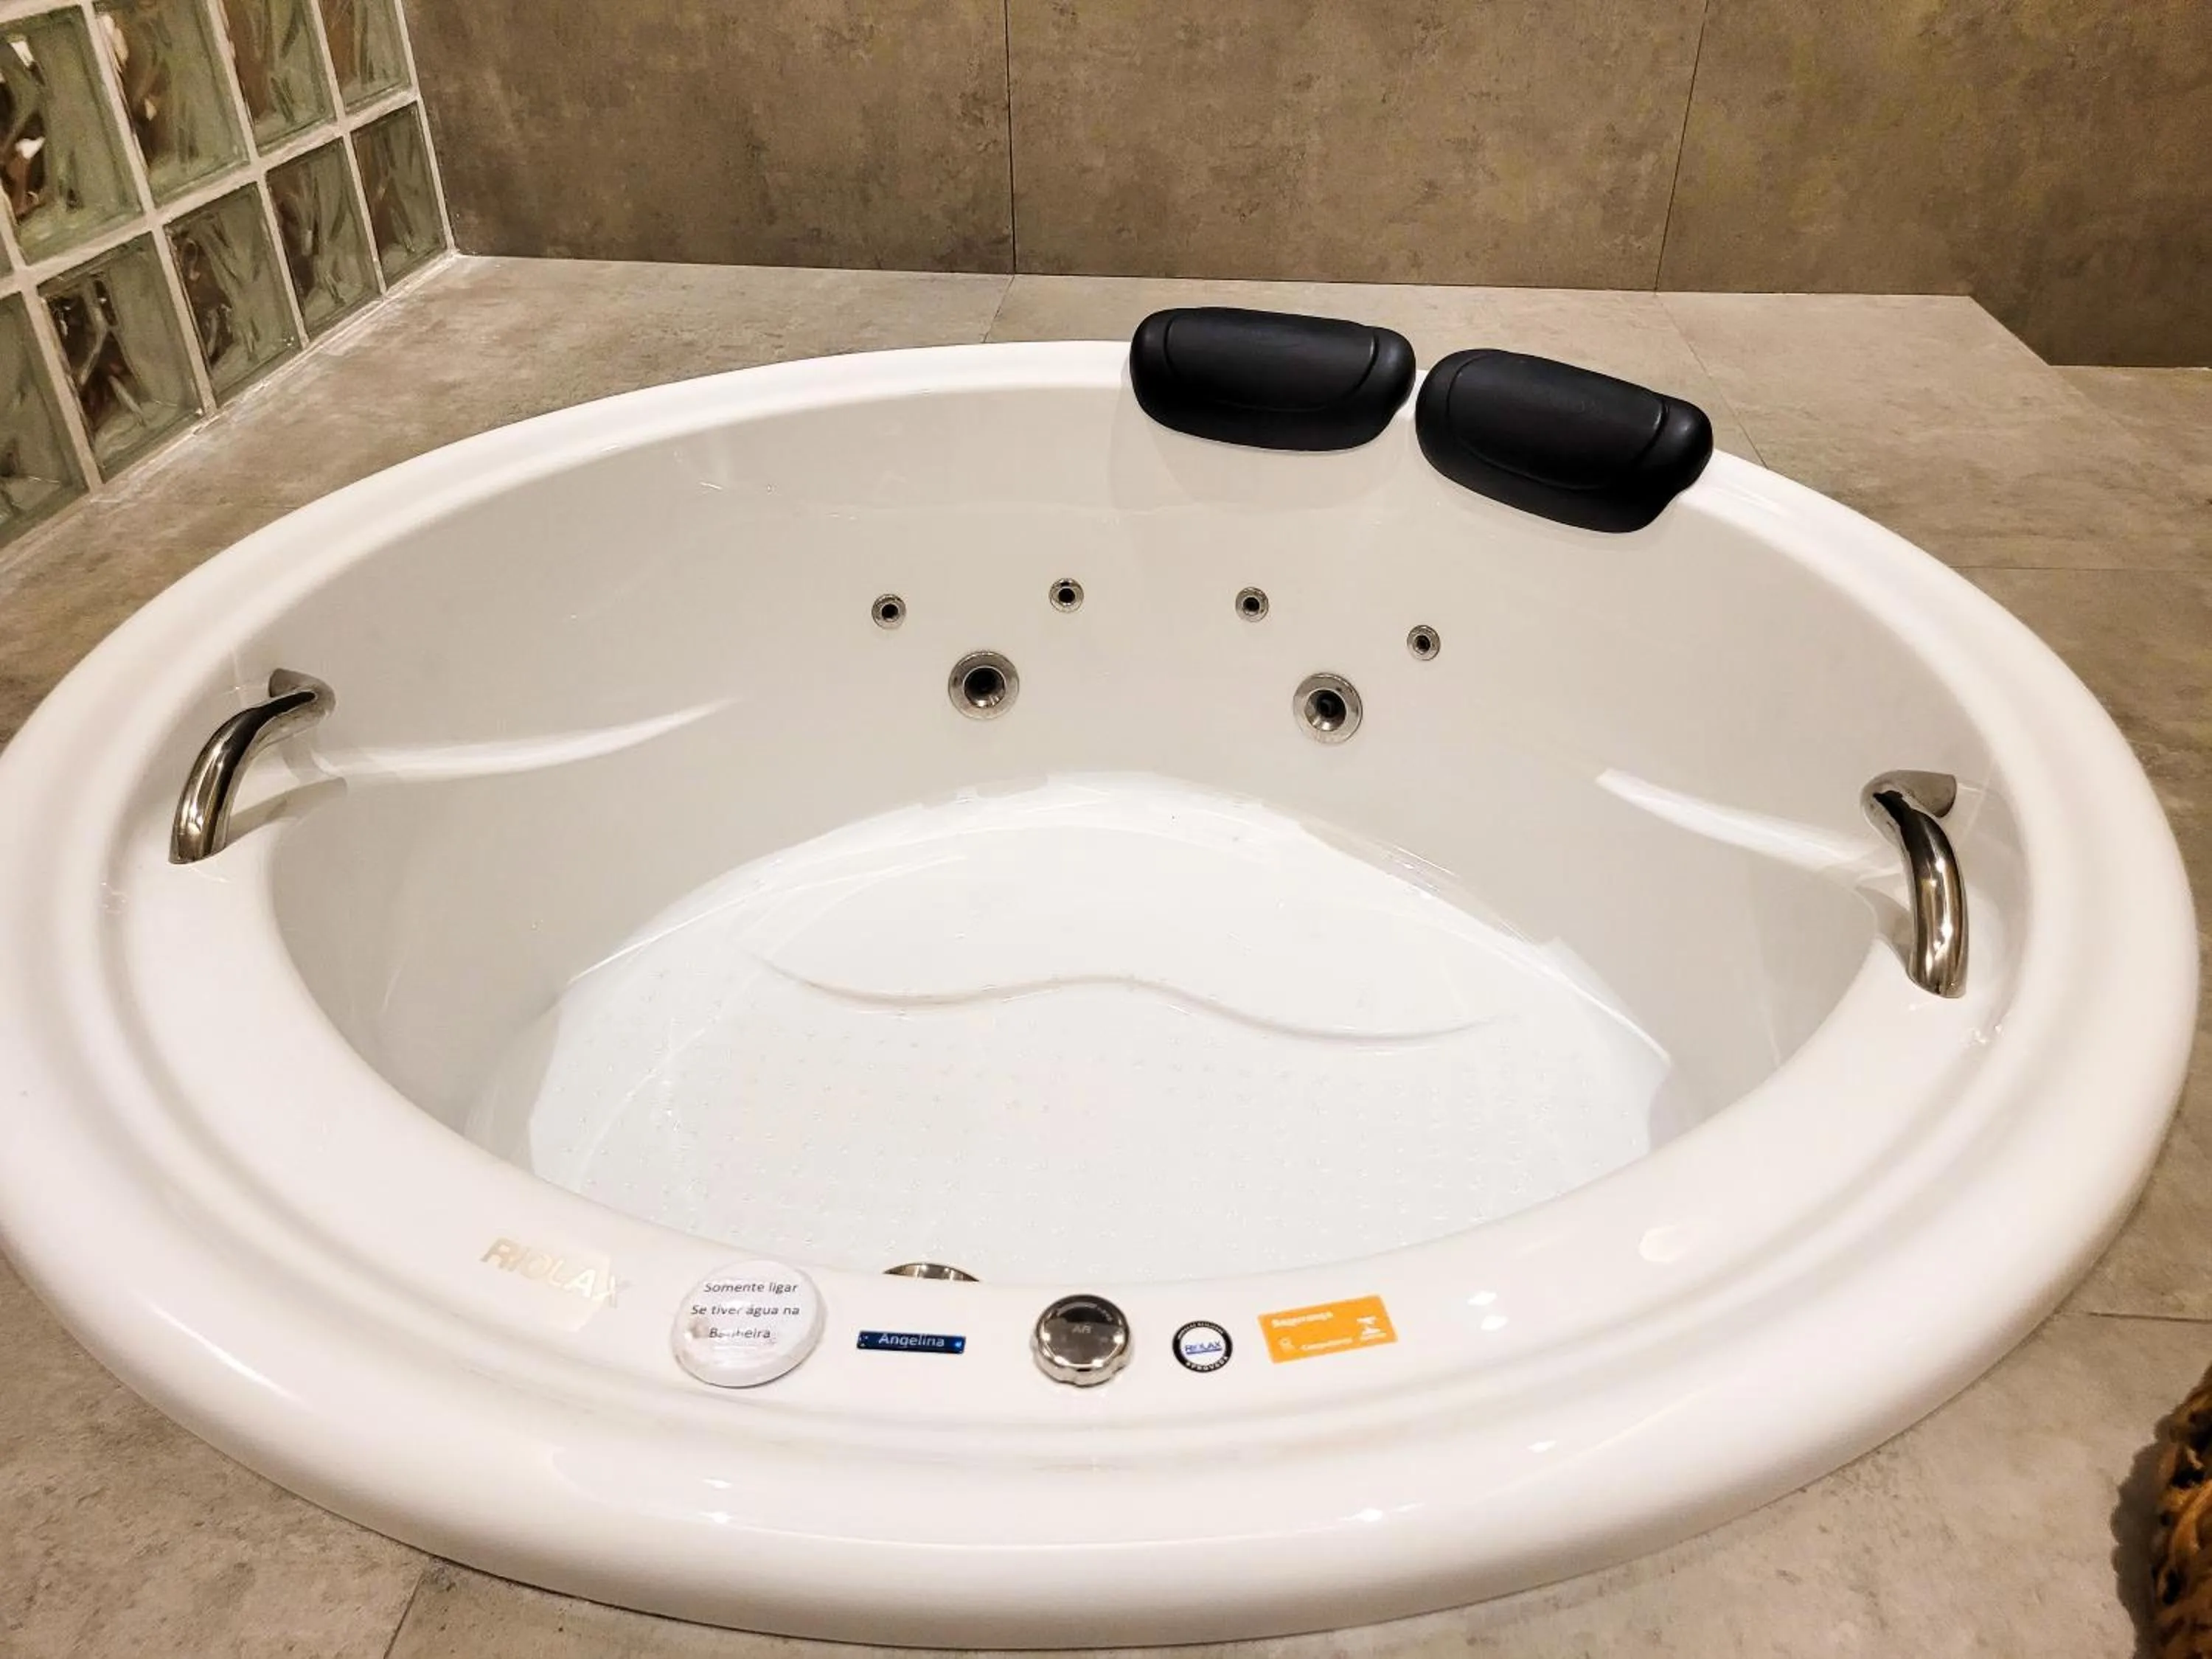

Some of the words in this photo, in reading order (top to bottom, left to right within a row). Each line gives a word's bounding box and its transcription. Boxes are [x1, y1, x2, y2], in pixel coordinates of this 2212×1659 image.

[703, 1282, 765, 1293] Somente
[769, 1282, 799, 1295] ligar
[691, 1304, 707, 1315] Se
[711, 1304, 743, 1315] tiver
[745, 1304, 779, 1318] água
[709, 1327, 771, 1338] Bheira
[878, 1333, 945, 1349] Angelina
